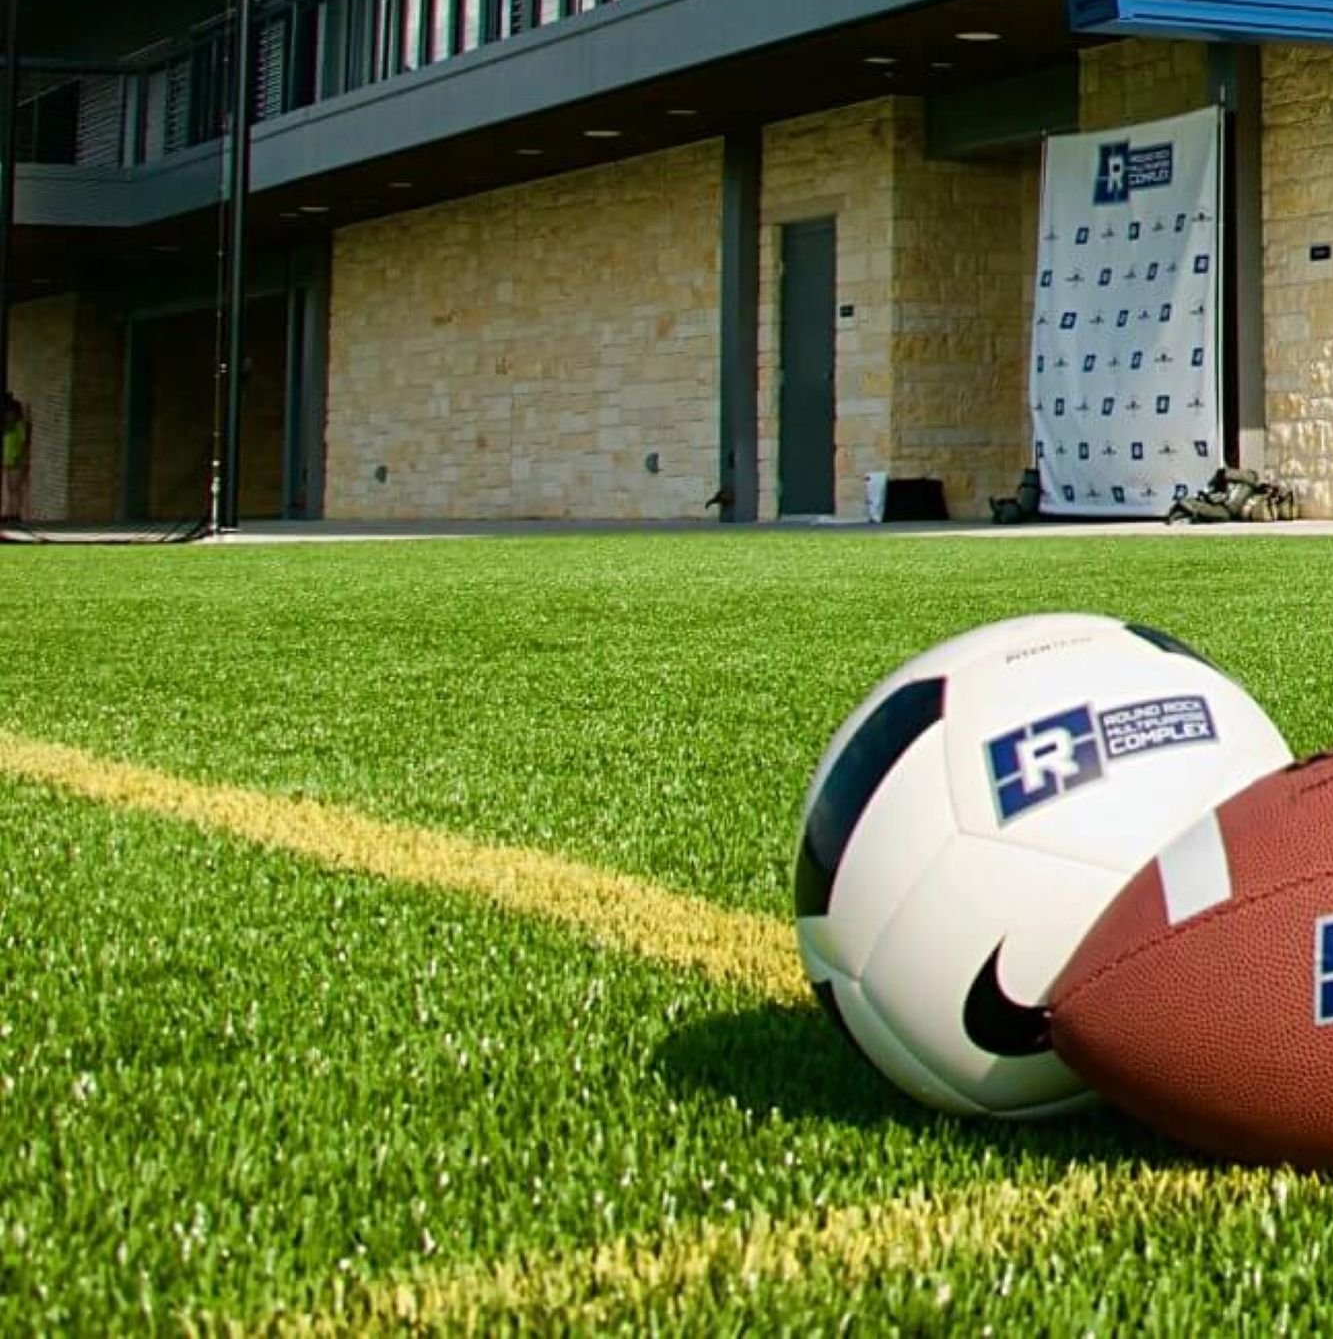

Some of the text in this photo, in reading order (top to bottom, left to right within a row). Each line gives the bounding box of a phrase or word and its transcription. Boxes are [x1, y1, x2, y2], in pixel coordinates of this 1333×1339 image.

[1103, 701, 1202, 726] ROUND ROCK
[1109, 721, 1211, 755] COMPLEX
[1015, 727, 1079, 795] R
